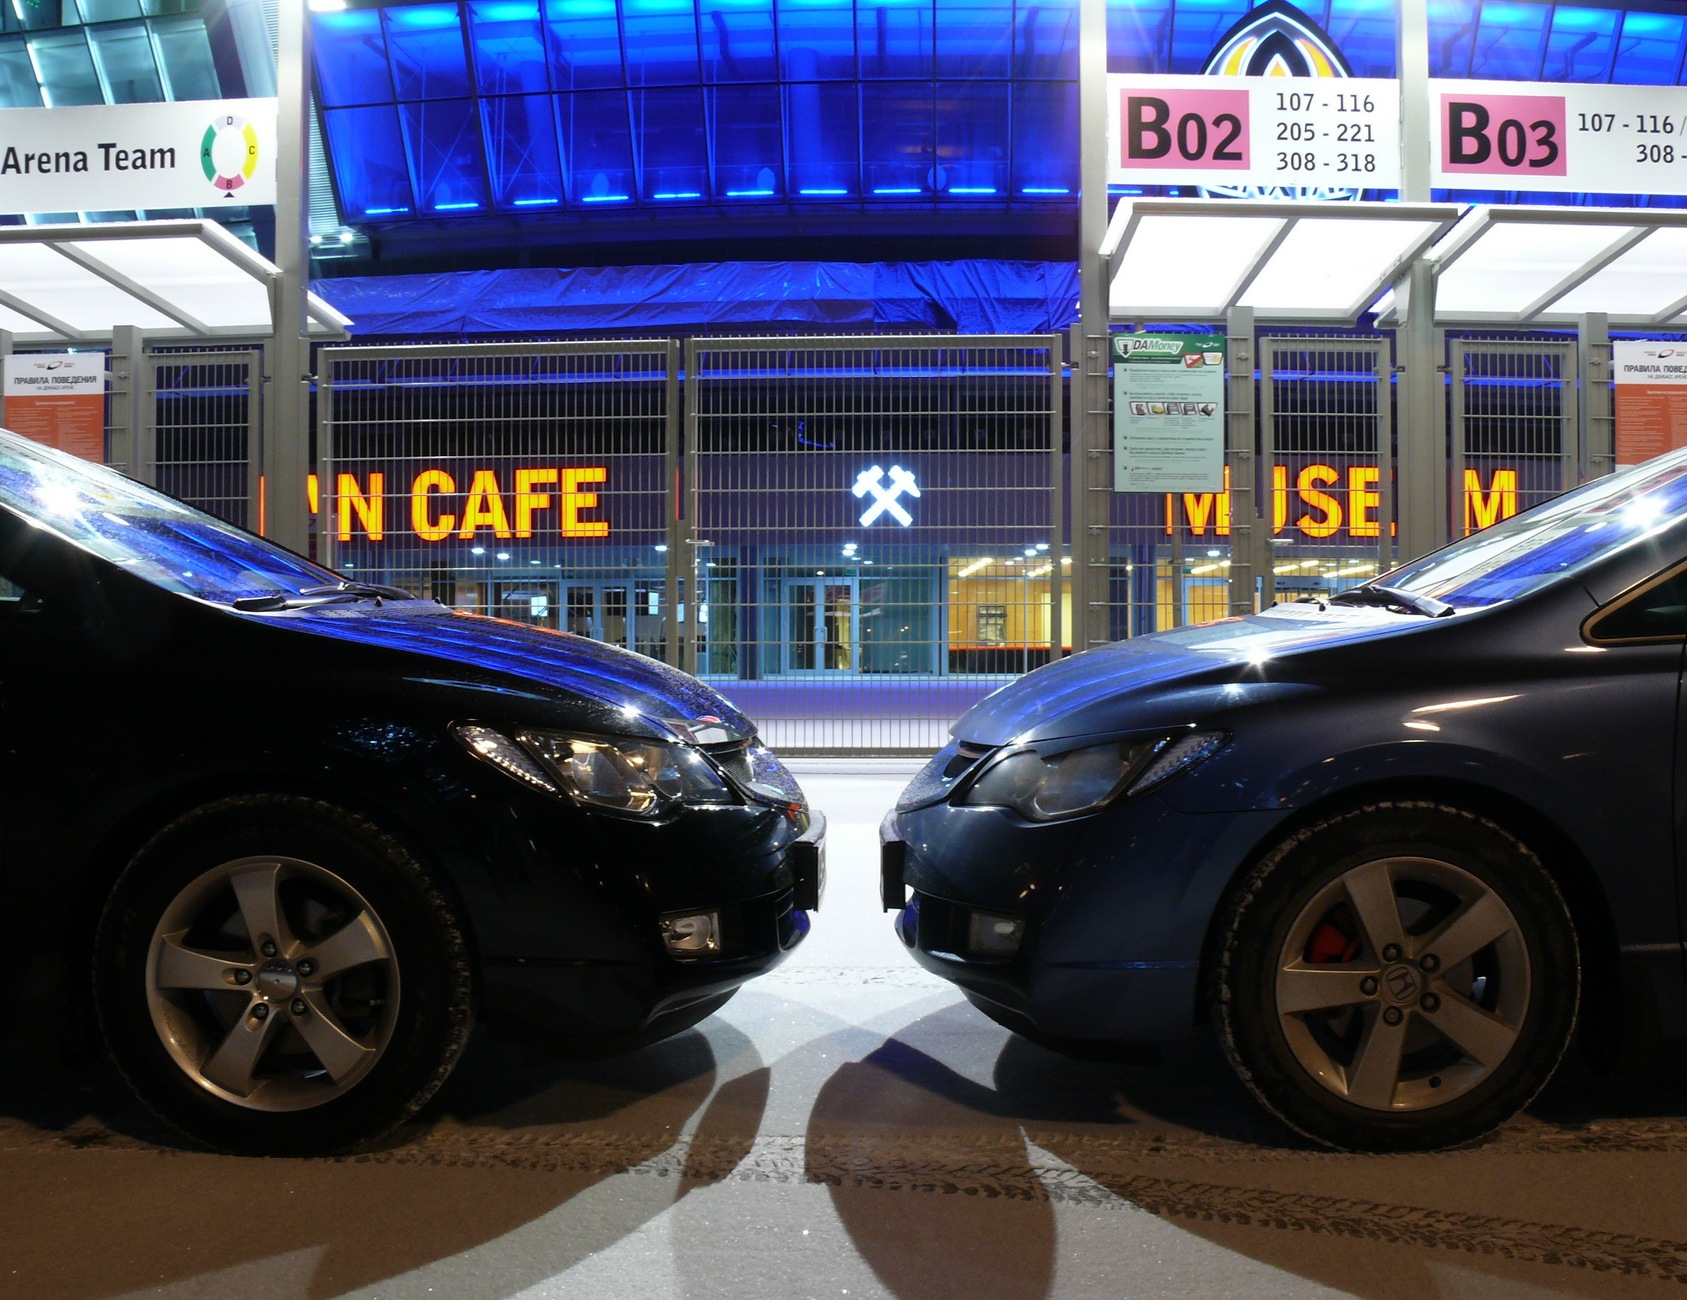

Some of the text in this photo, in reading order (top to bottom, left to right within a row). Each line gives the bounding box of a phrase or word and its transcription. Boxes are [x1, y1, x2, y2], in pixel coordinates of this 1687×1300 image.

[1276, 92, 1315, 111] 107
[1336, 94, 1375, 113] 116
[226, 116, 234, 126] D
[1127, 96, 1243, 162] B02
[1578, 113, 1616, 133] 107
[1636, 115, 1674, 134] 116
[1276, 123, 1316, 142] 205
[1336, 124, 1376, 143] 221
[1448, 102, 1559, 168] B03
[1, 142, 176, 175] Arena Team
[202, 148, 211, 158] A
[248, 145, 256, 156] C
[1636, 144, 1675, 164] 308
[1276, 152, 1316, 171] 308
[1336, 153, 1376, 173] 318
[226, 180, 233, 190] B
[1132, 339, 1182, 353] DAMoney
[1623, 365, 1661, 373] ПРАВИЛА
[14, 375, 97, 385] ПРАВИЛА ПОВЕДЕНИЯ
[411, 466, 609, 542] CAFE
[1165, 464, 1517, 537] MSEM
